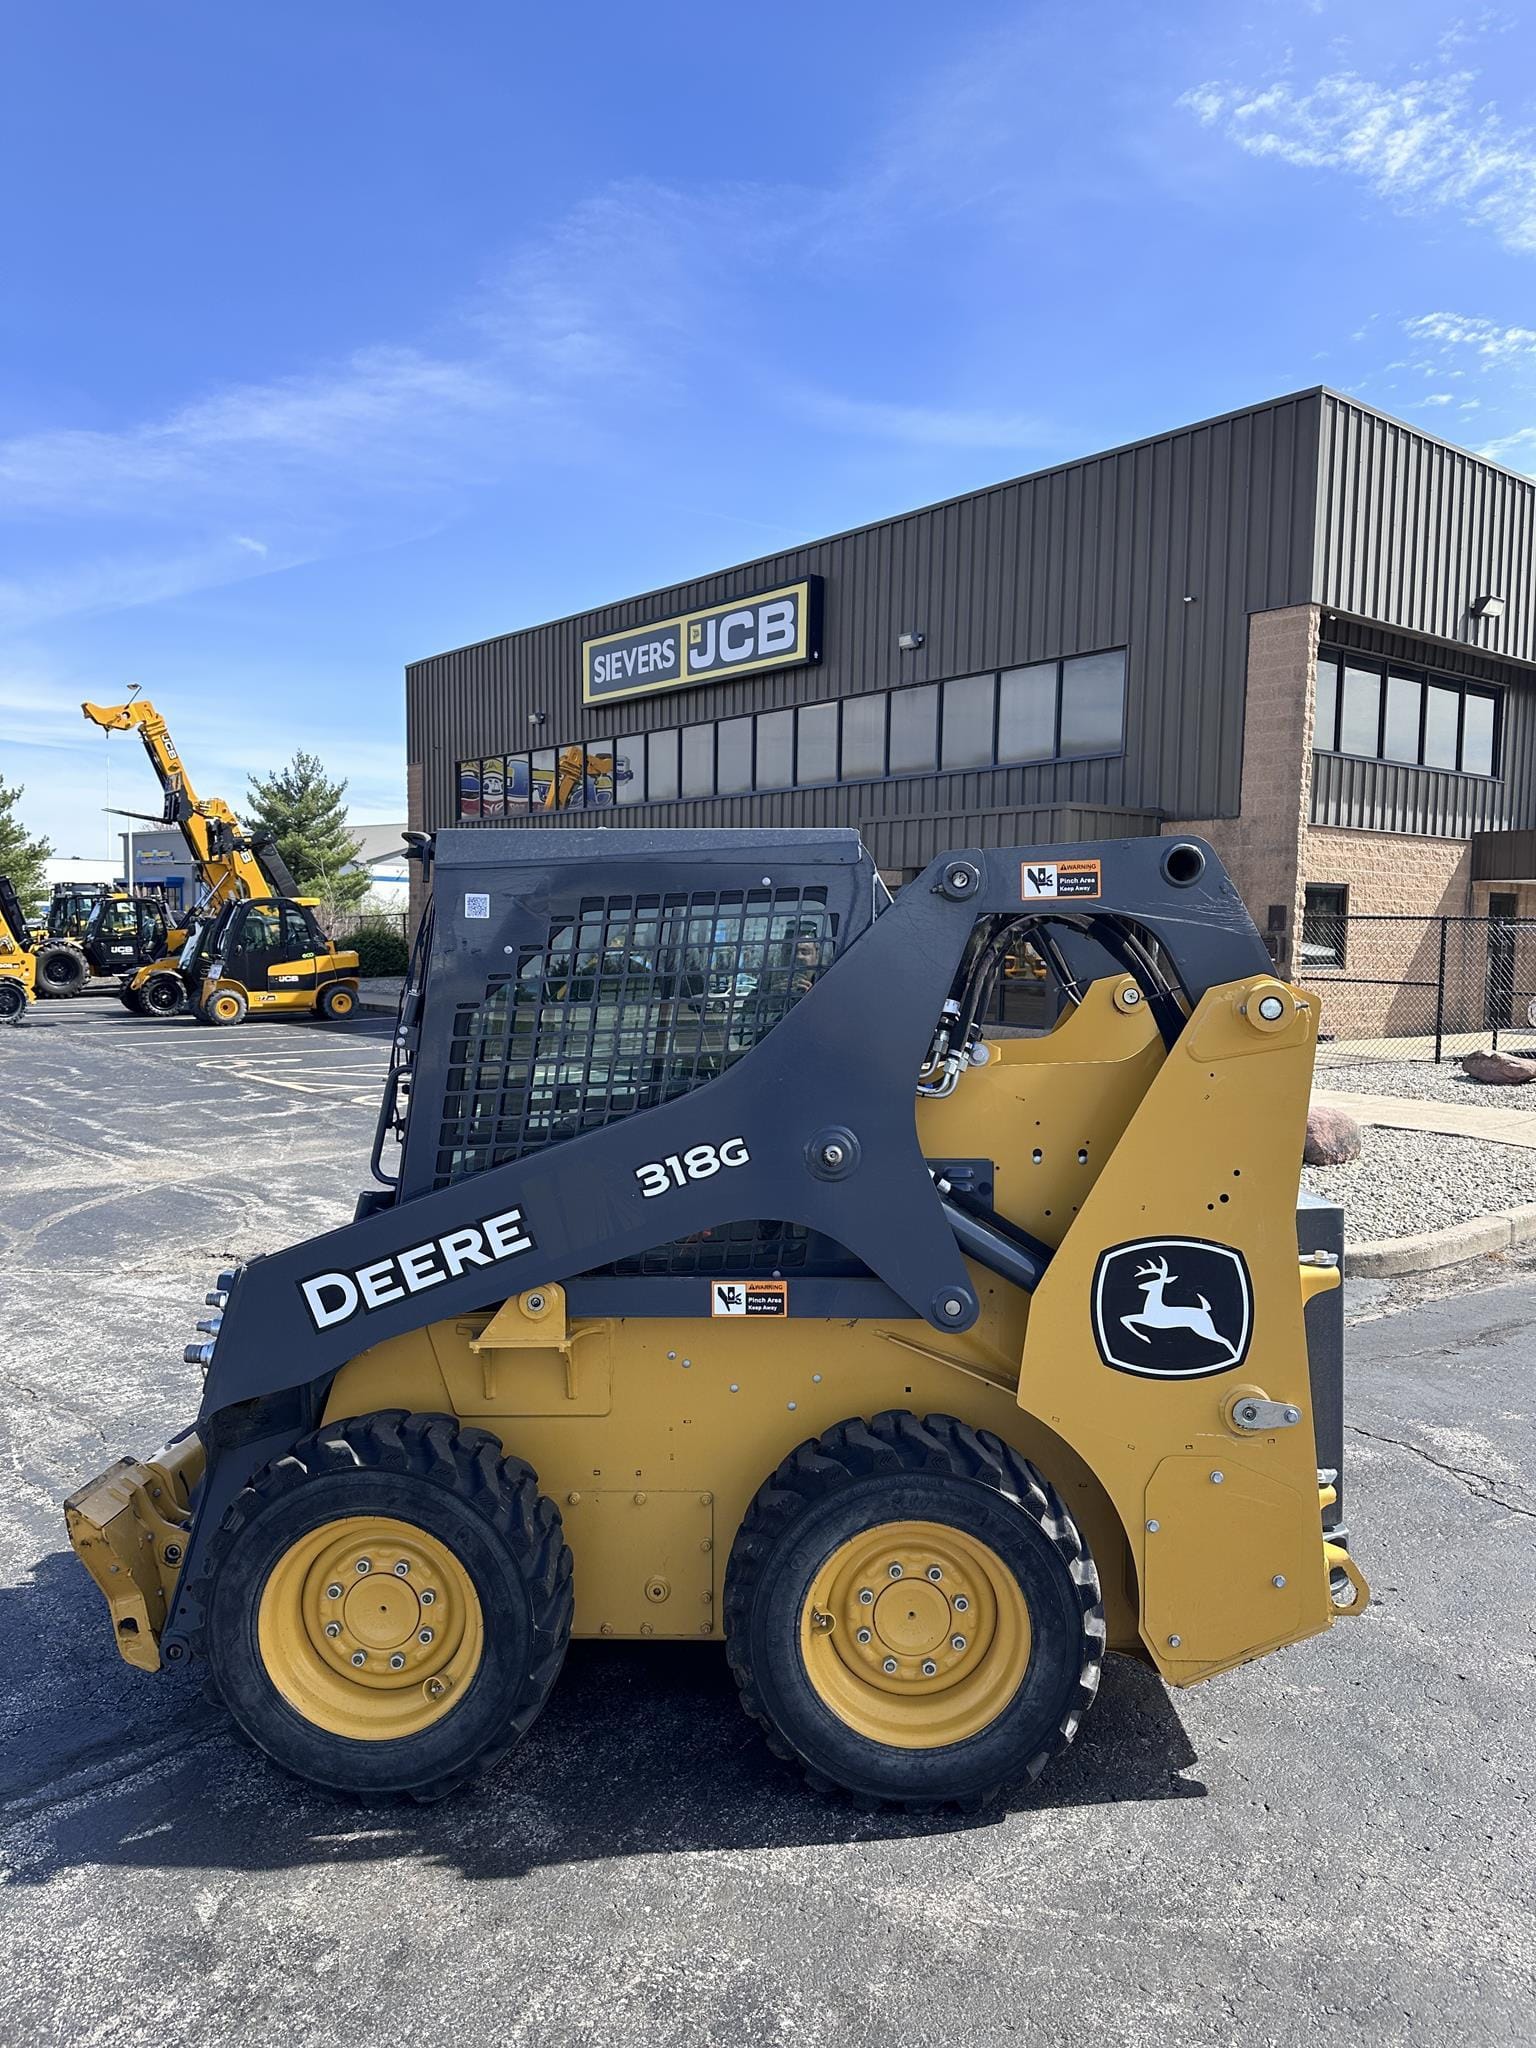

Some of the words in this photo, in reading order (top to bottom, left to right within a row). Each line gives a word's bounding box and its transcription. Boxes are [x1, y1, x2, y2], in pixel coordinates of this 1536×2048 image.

[593, 638, 676, 684] SIEVERS
[689, 600, 796, 669] JCB
[161, 734, 177, 760] JCB
[635, 1137, 750, 1198] 318G
[301, 1208, 532, 1329] DEERE
